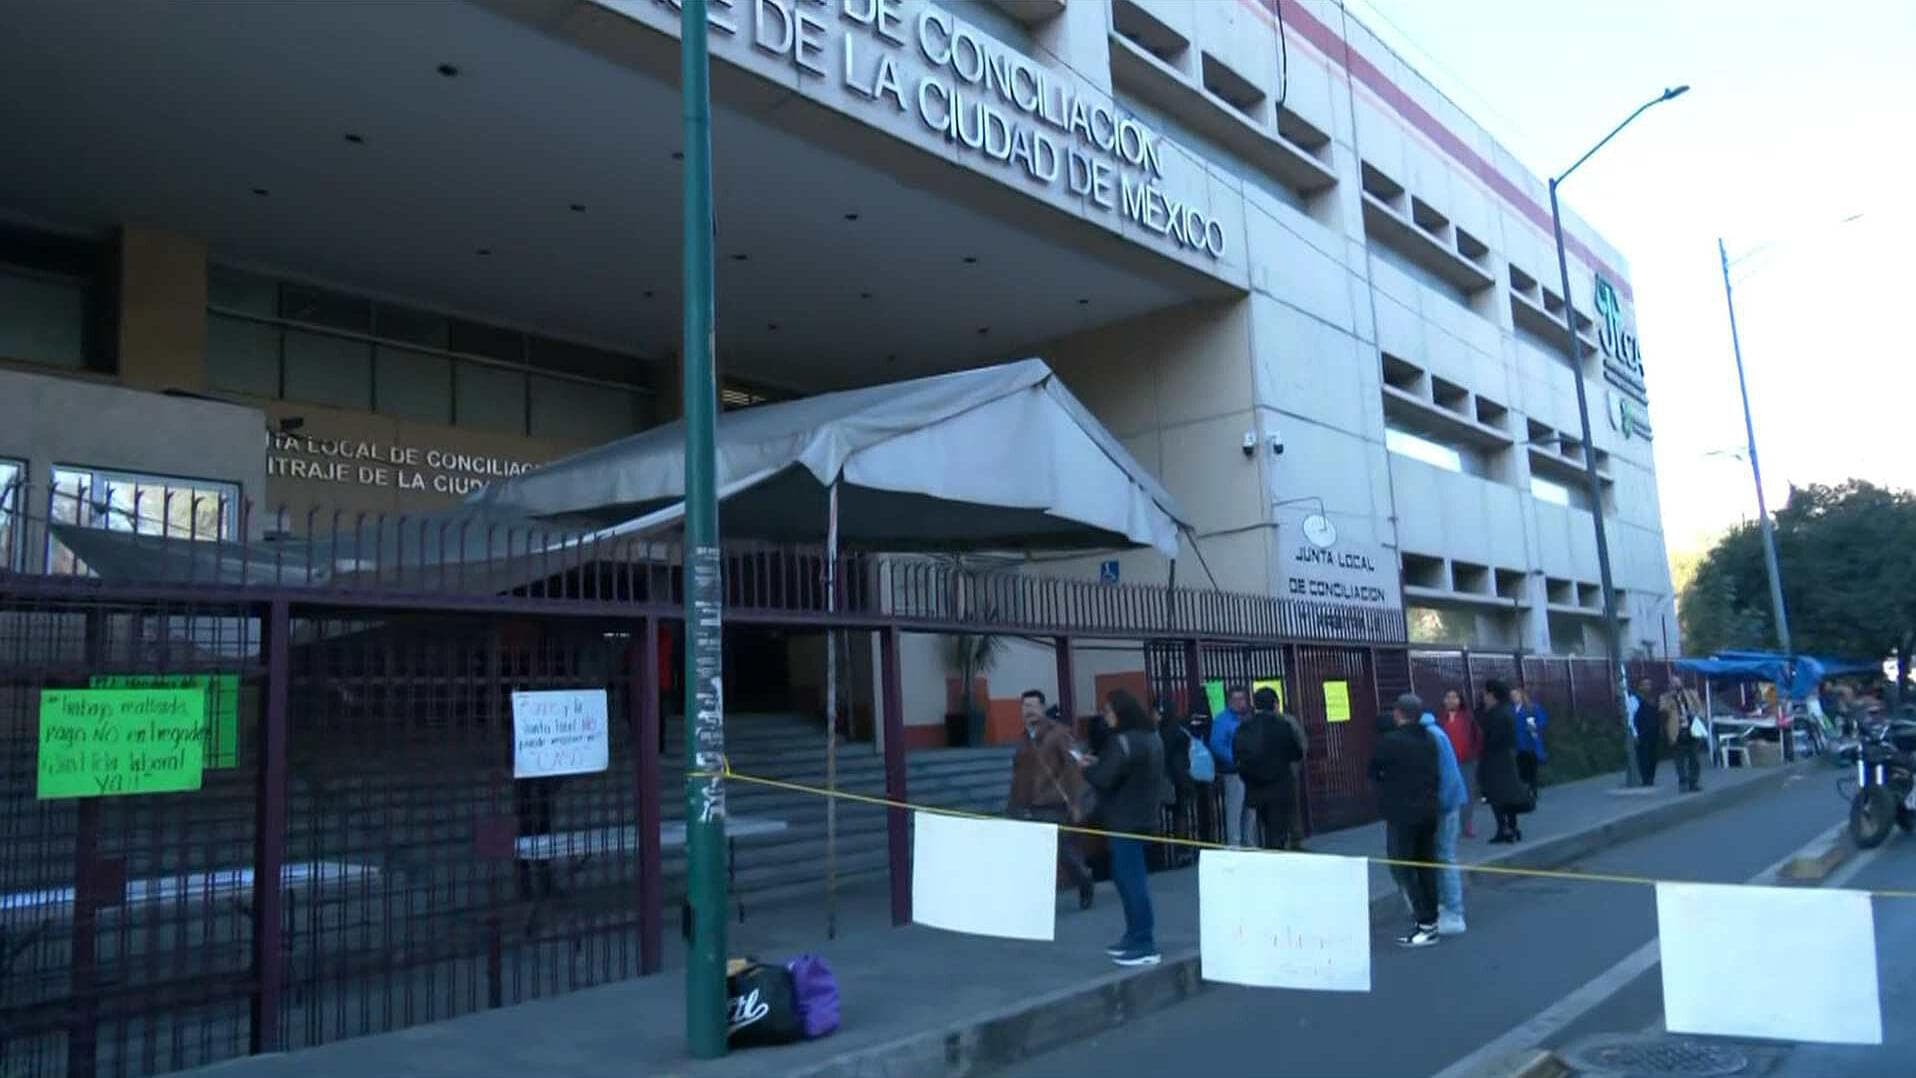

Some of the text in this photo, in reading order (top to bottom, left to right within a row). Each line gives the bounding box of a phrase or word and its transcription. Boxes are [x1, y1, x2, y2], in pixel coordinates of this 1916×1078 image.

[754, 0, 826, 77] DE
[845, 31, 907, 112] LA
[918, 76, 1058, 184] CIUDAD
[1065, 146, 1114, 212] DE
[1120, 173, 1226, 259] MÉXICO
[307, 437, 385, 462] LOCAL
[390, 447, 420, 467] DE
[358, 466, 389, 487] DE
[398, 469, 426, 490] LA
[1295, 546, 1375, 572] JUNTA LOCAL
[1288, 577, 1385, 602] DE CONCILIACION
